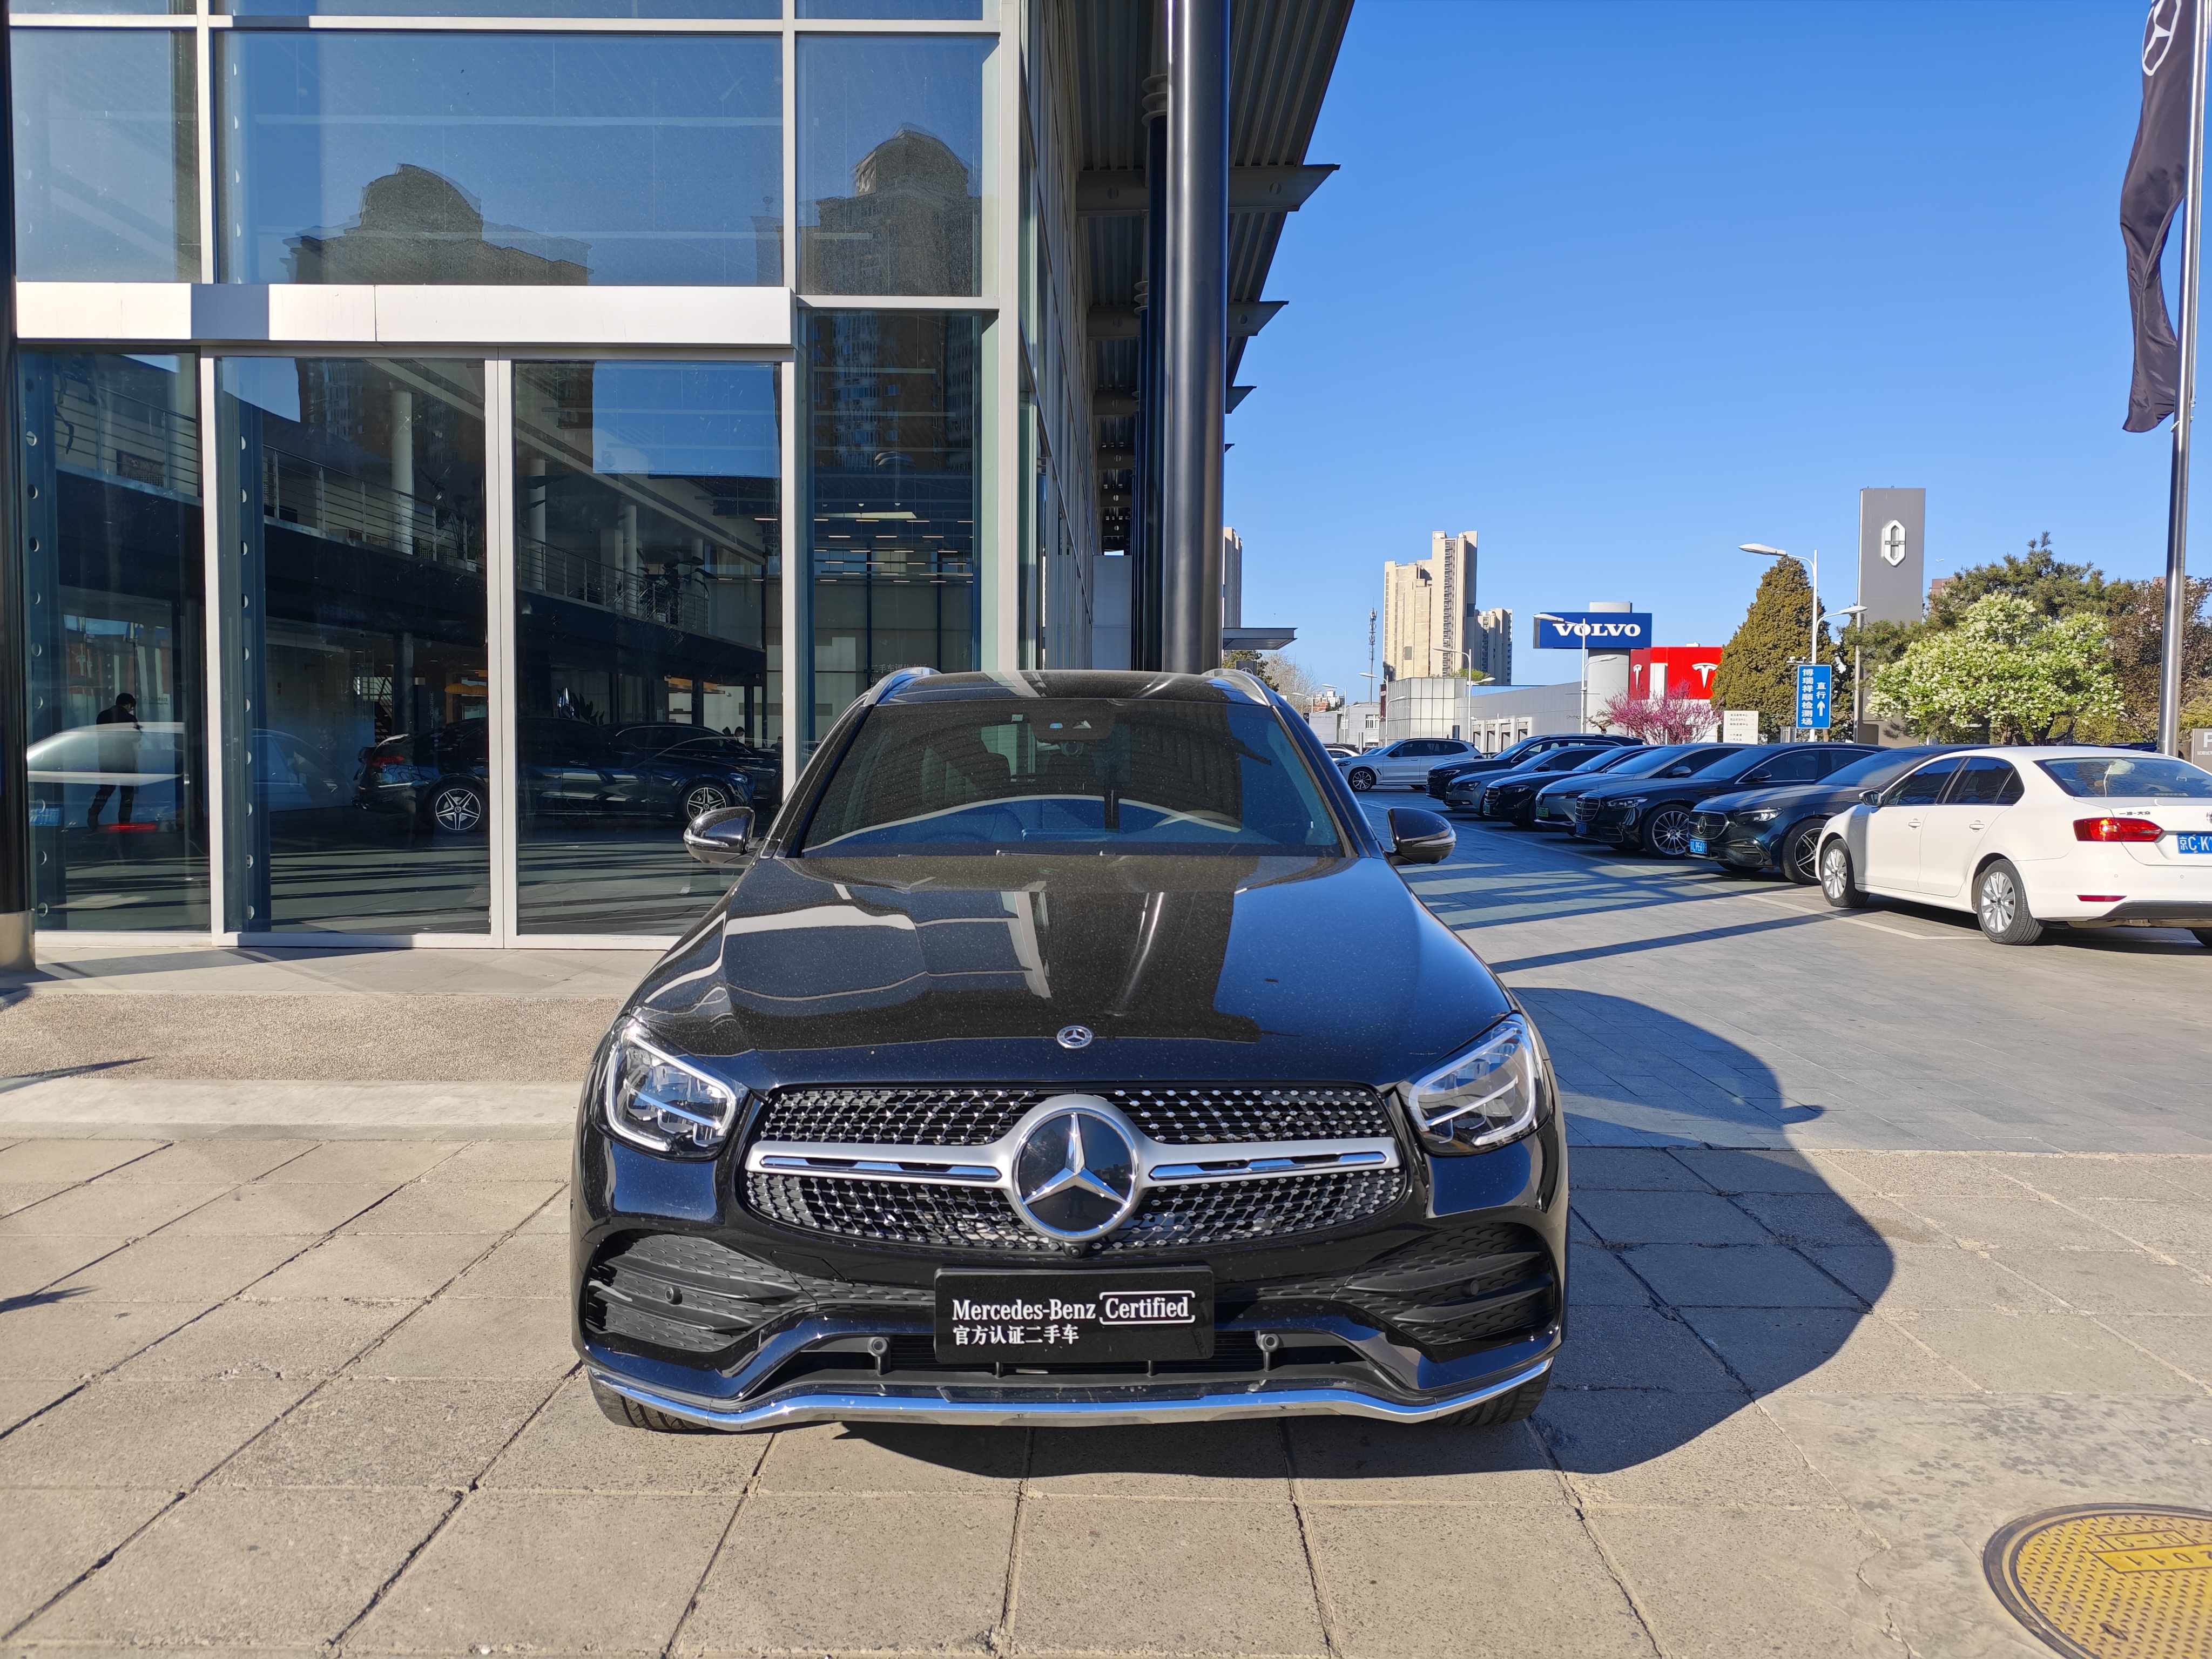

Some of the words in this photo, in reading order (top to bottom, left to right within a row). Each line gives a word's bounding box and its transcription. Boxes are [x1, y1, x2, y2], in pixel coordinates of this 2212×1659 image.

[1553, 623, 1641, 637] VOLVO
[1801, 669, 1814, 725] 博瑞祥顺检测场
[1816, 682, 1827, 699] 直行
[2179, 836, 2212, 851] 京C·K
[952, 1298, 1096, 1321] Mercedes-Benz
[1105, 1296, 1189, 1319] Certified
[953, 1323, 1080, 1346] 官方认证二手车
